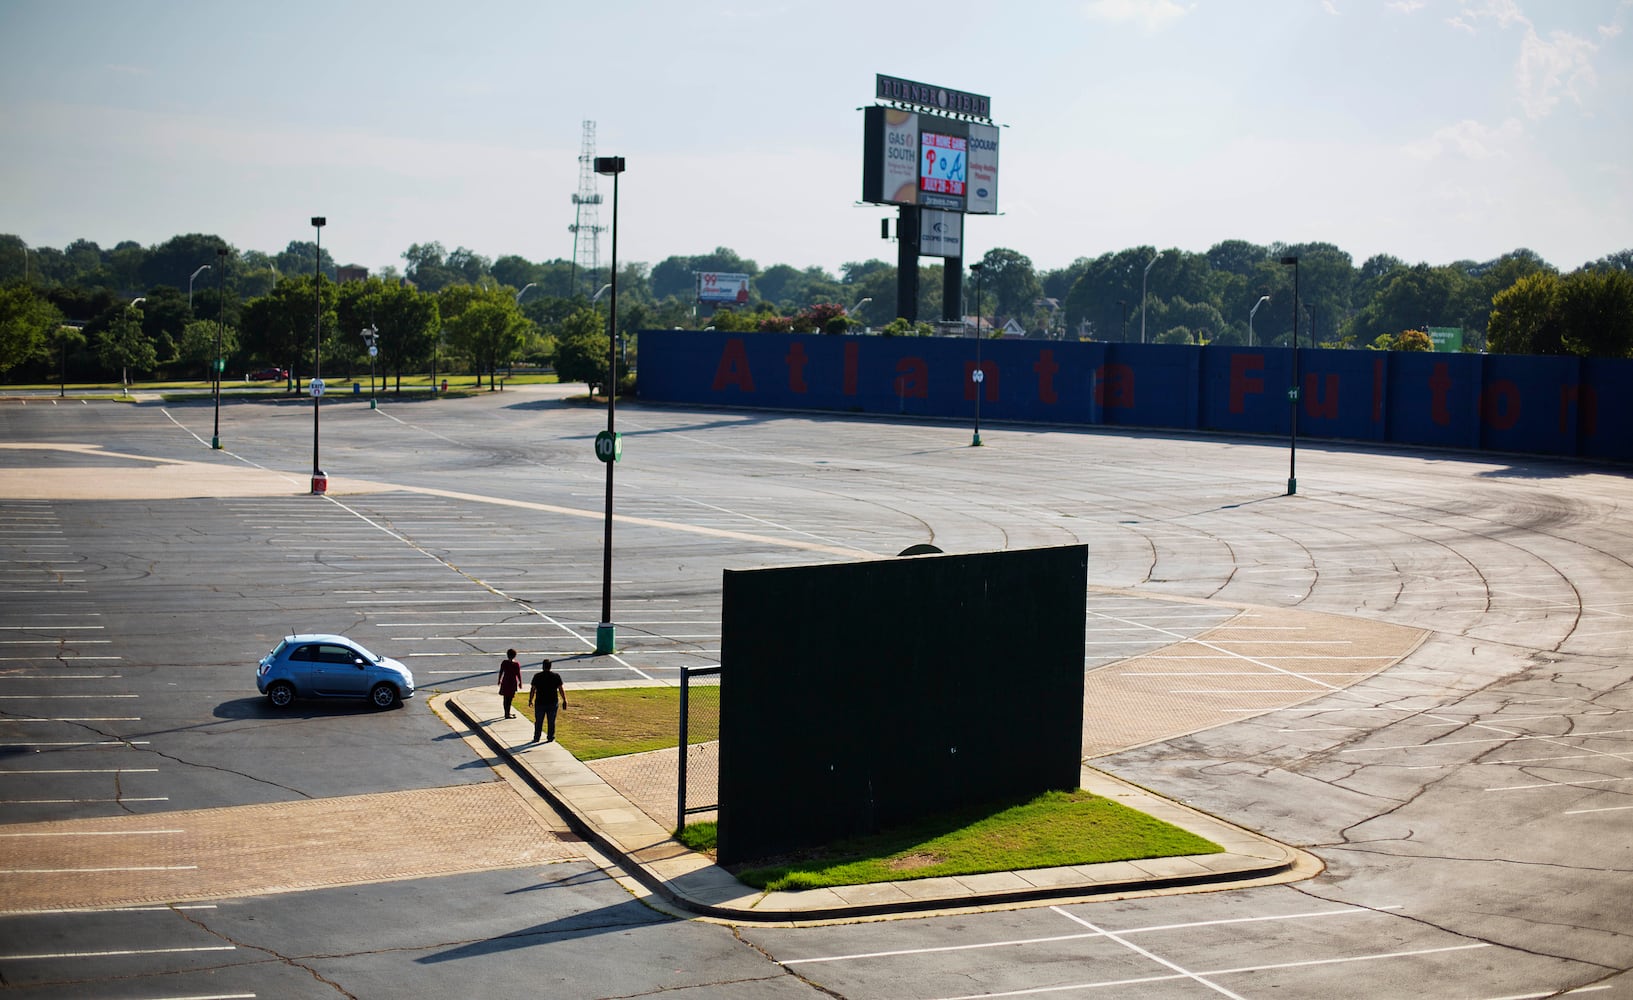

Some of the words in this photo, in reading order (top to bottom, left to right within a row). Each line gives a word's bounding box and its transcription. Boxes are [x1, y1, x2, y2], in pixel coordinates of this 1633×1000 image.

[883, 79, 937, 104] TURNER
[948, 93, 986, 113] FIELD
[888, 131, 905, 146] GAS
[887, 147, 915, 161] SOUTH
[1287, 390, 1298, 399] 11
[597, 438, 613, 455] 10
